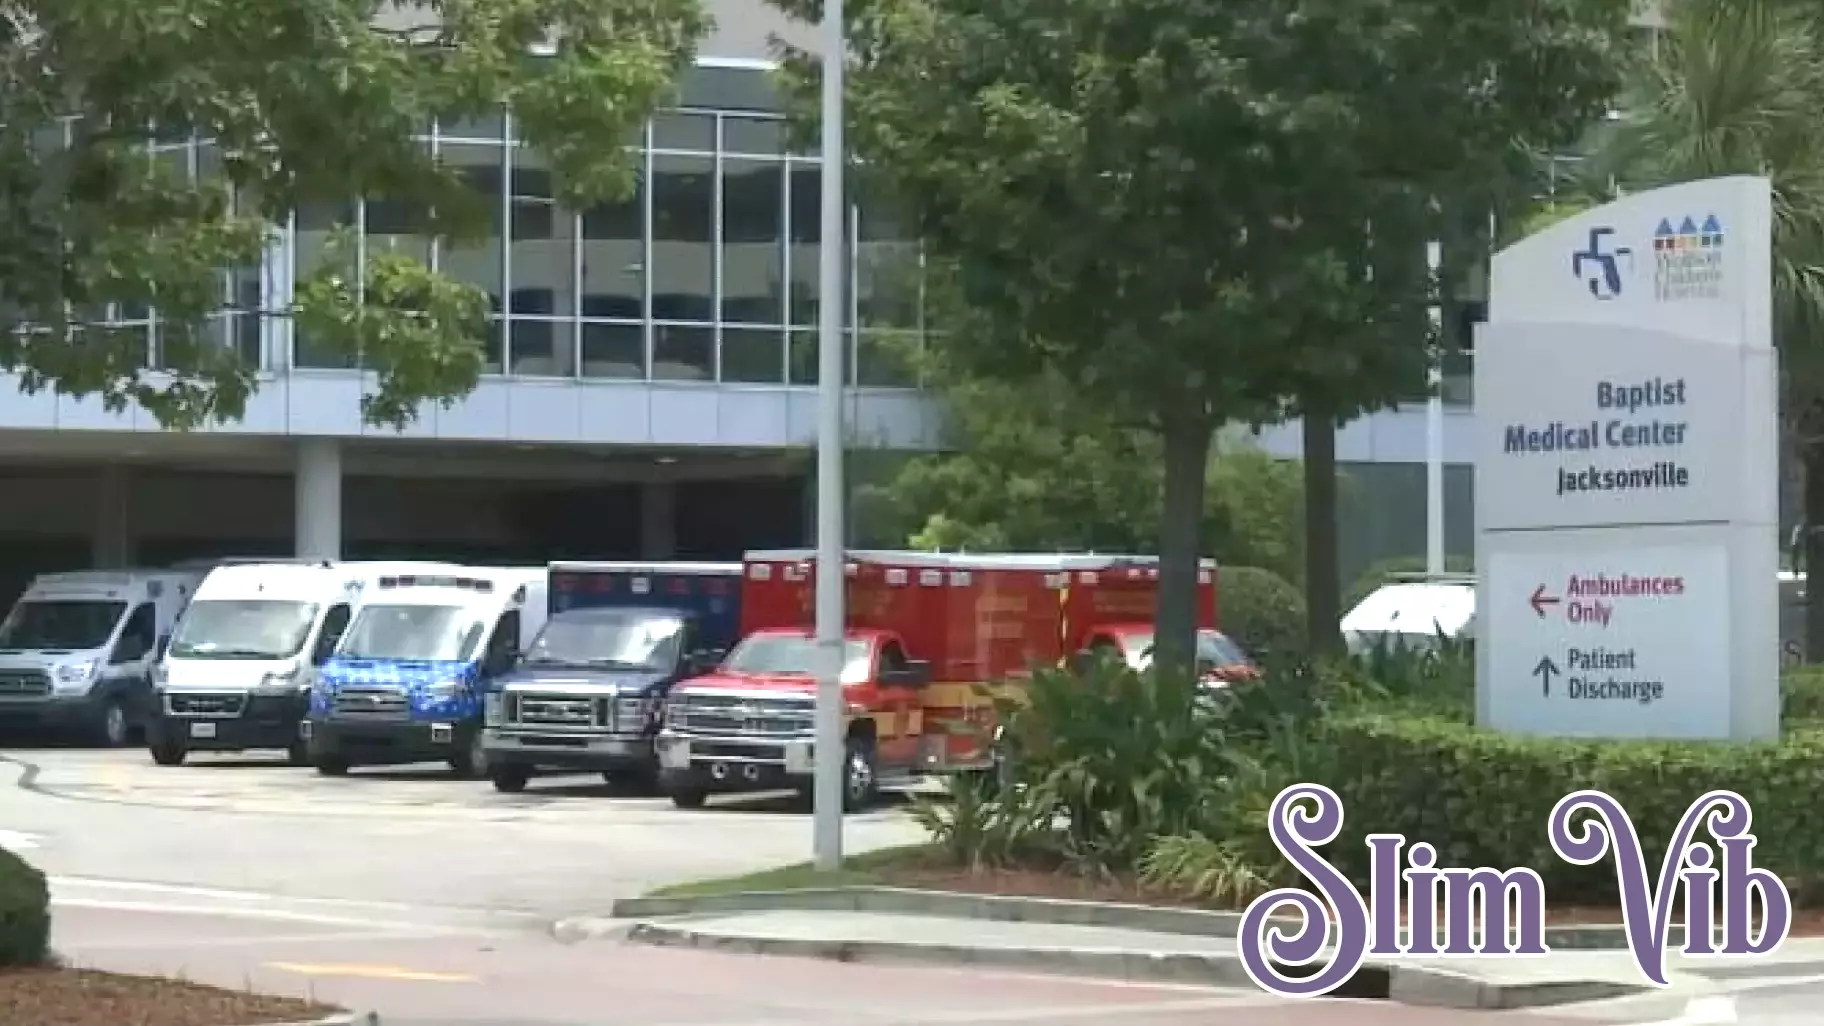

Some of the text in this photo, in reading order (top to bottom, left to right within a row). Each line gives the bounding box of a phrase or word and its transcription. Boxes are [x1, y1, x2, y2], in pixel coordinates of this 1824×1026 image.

[1597, 377, 1686, 411] Baptist
[1504, 419, 1688, 454] Medical Center
[1556, 462, 1689, 495] Jacksonville
[1566, 572, 1685, 598] Ambulances
[1567, 601, 1613, 627] Only
[1567, 648, 1637, 670] Patient
[1568, 677, 1664, 703] Discharge
